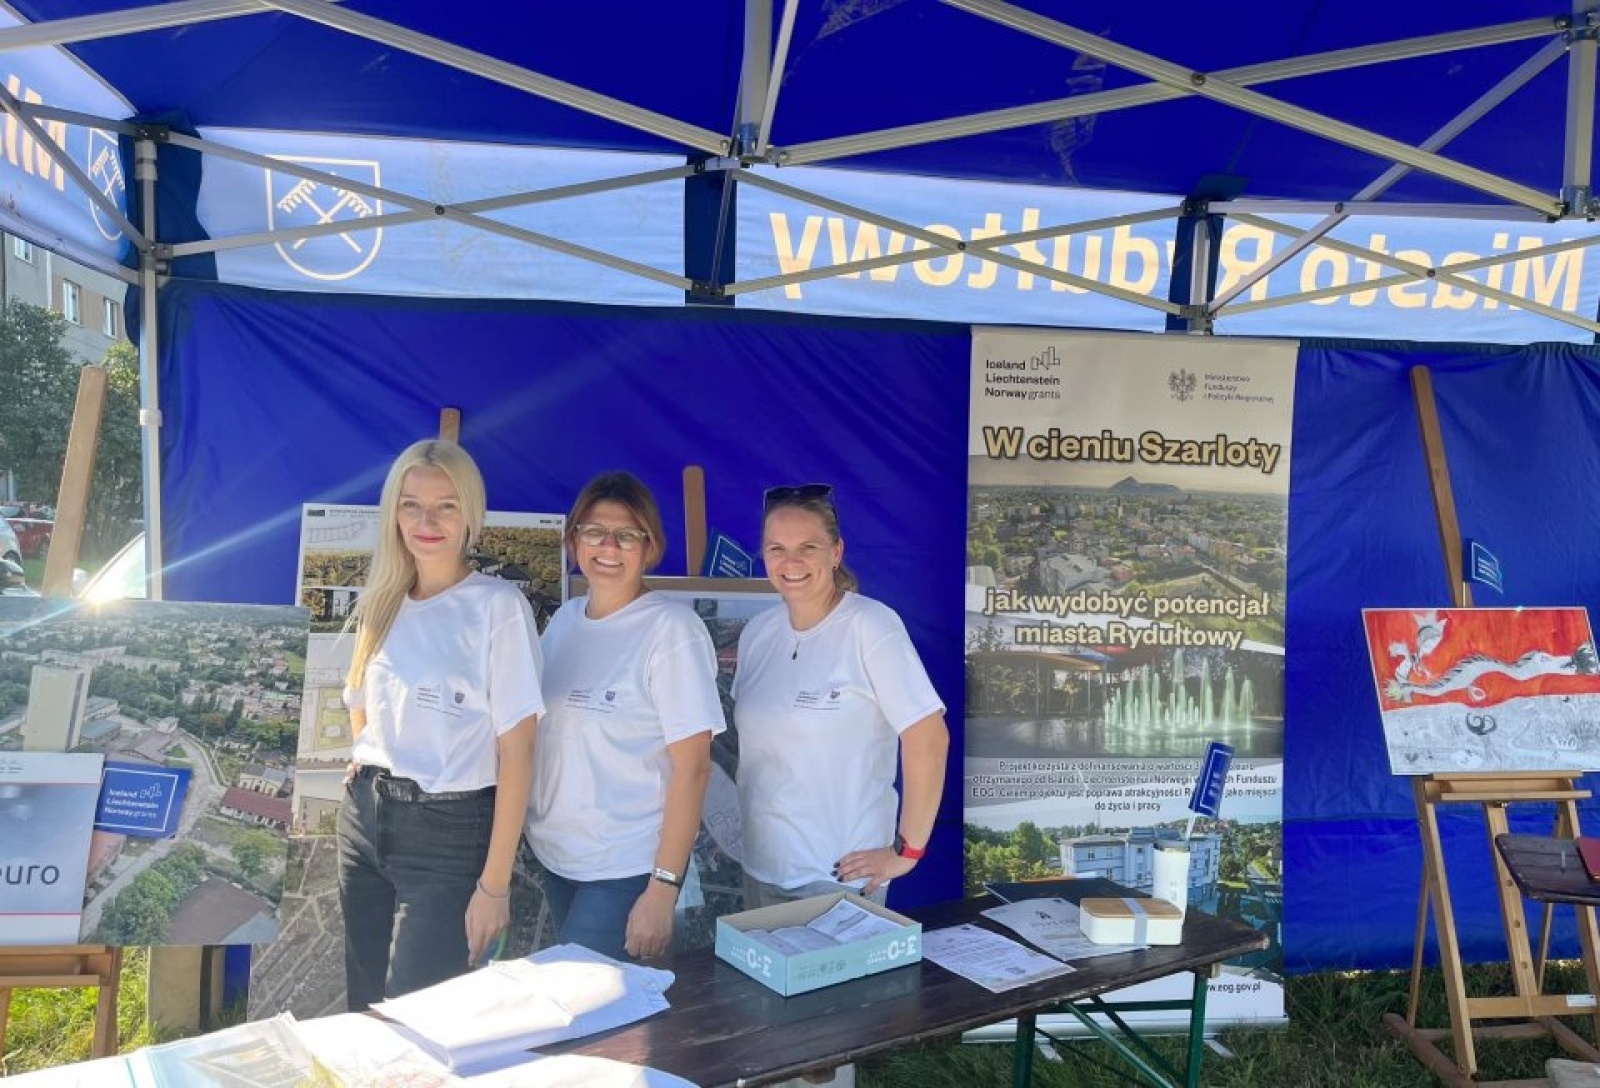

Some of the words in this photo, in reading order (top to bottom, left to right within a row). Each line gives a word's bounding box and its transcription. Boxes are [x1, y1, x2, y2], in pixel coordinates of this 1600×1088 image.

[986, 359, 1026, 370] Iceland
[986, 373, 1061, 385] Liechtenstein
[985, 387, 1027, 400] Norway
[1028, 391, 1061, 401] grants
[983, 426, 1023, 460] W
[1027, 428, 1134, 463] cieniu
[1139, 431, 1280, 473] Szarloty
[984, 589, 1028, 615] jak
[1033, 591, 1149, 617] wydobyć
[1154, 592, 1270, 619] potencjał
[1015, 621, 1102, 645] miasta
[1107, 622, 1243, 650] Rydułtowy
[1236, 775, 1277, 784] Funduszu
[108, 788, 138, 798] Iceland
[1029, 789, 1066, 799] projektu
[1067, 789, 1083, 799] jest
[1086, 789, 1122, 799] poprawa
[1124, 788, 1182, 799] atrakcyjności
[1225, 788, 1244, 799] jako
[106, 798, 159, 809] Liechtenstein
[1094, 801, 1106, 810] do
[1108, 801, 1130, 812] życia
[1138, 801, 1161, 812] pracy
[0, 864, 60, 885] uro
